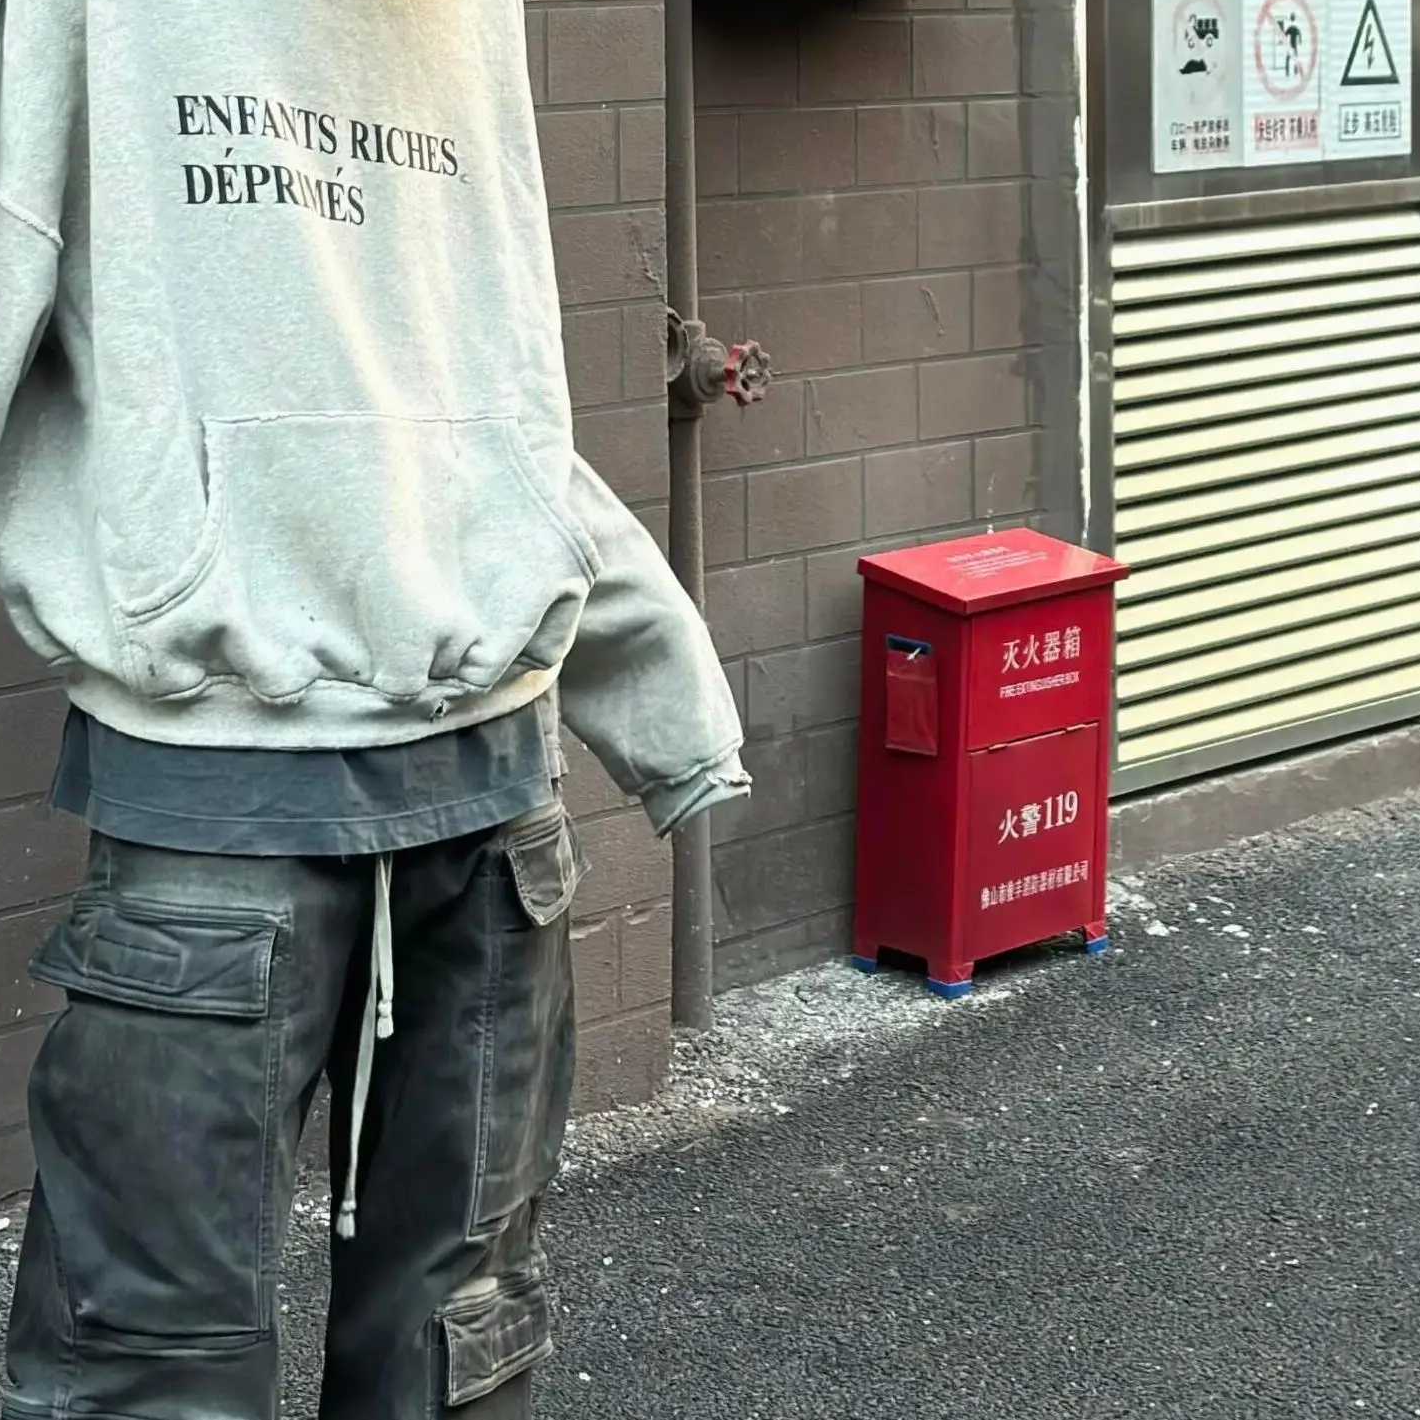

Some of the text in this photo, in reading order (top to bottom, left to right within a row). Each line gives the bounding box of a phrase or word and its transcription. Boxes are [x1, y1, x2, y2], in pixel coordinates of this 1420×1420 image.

[173, 95, 459, 177] ENFANTS RICHES
[181, 147, 366, 226] DÉPRIMÉS
[1001, 625, 1081, 674] 灭火器箱
[997, 790, 1079, 845] 火警119
